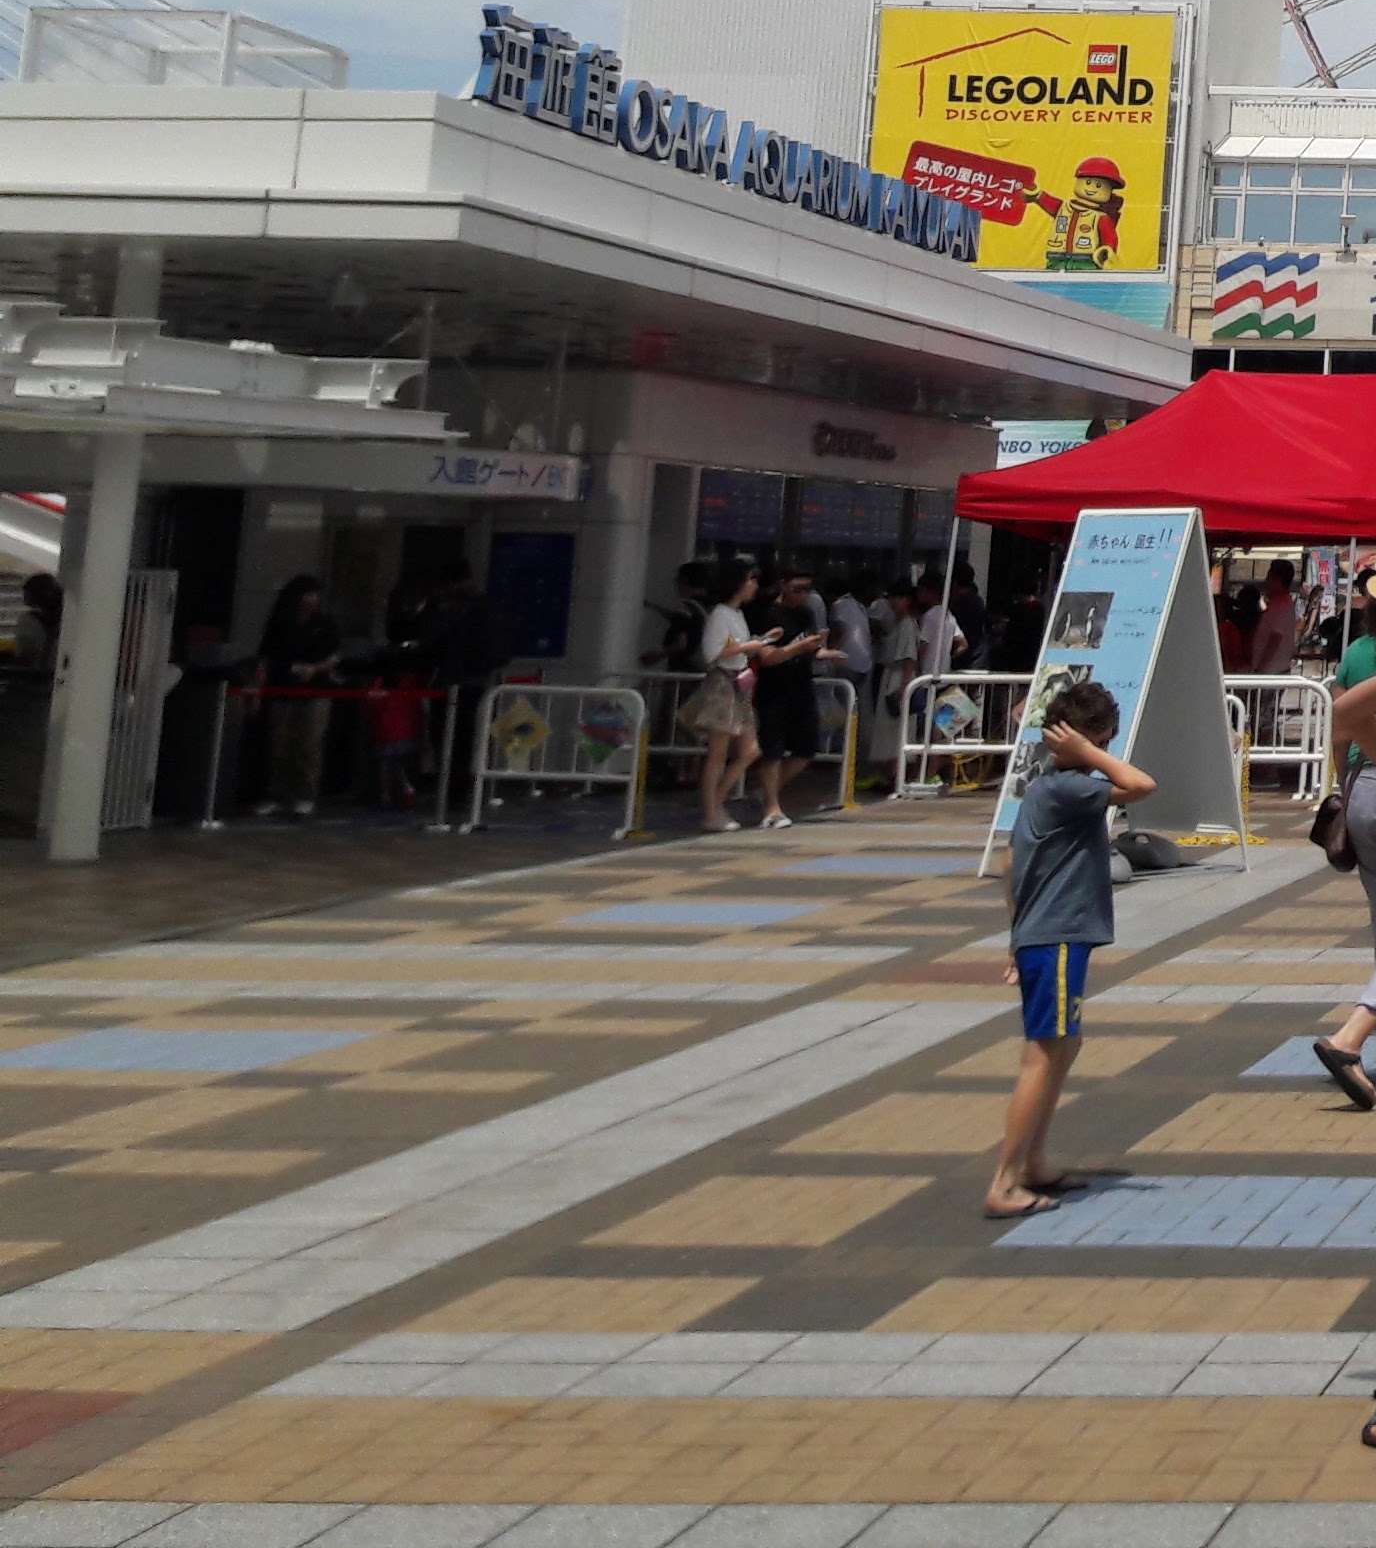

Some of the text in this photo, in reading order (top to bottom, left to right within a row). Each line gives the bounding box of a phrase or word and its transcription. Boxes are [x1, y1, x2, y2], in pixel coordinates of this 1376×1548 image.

[947, 45, 1154, 106] LEGOLAND
[1089, 53, 1116, 65] LEGO
[945, 108, 1154, 124] DISCOVERY CENTER
[617, 79, 730, 182] OSAKA
[730, 120, 872, 228] AQUARIUM
[868, 172, 982, 263] KAIYUKAN
